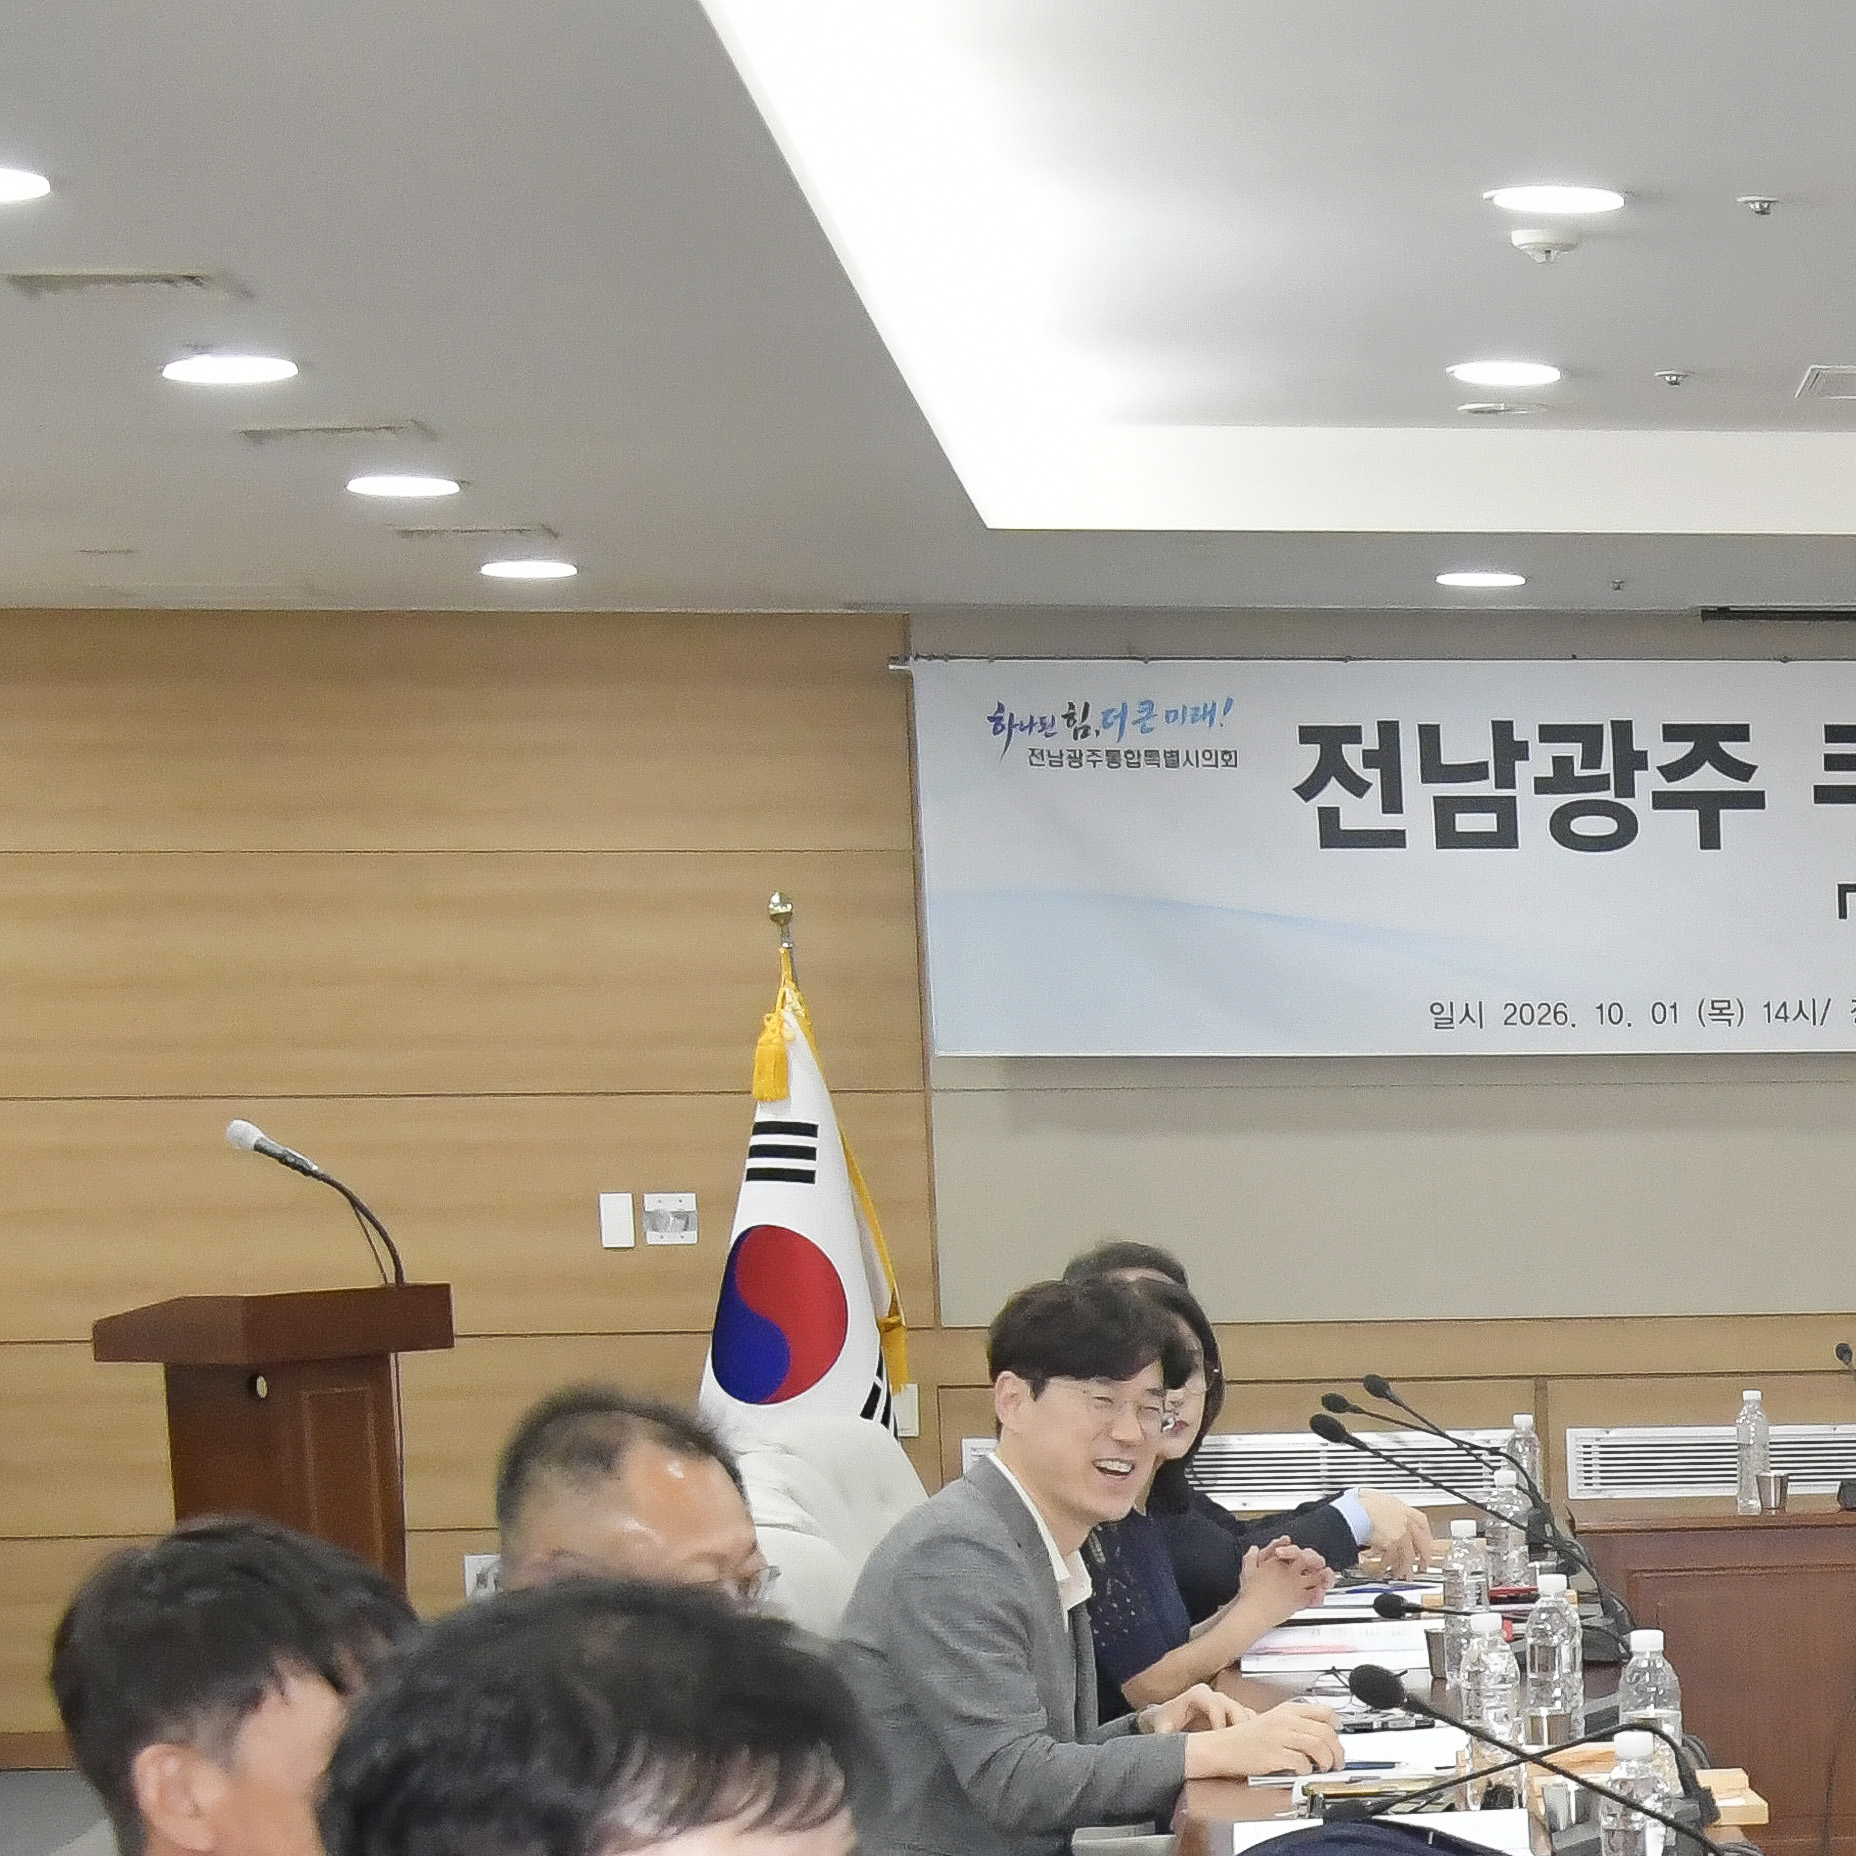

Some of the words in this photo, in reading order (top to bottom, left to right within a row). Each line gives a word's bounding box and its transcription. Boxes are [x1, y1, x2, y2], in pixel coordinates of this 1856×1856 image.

[987, 701, 1058, 762] 하나된
[1101, 702, 1128, 743] 더
[1132, 700, 1158, 734] 큰
[1164, 698, 1234, 729] 미래!
[1028, 747, 1239, 770] 전남광주통합특별시의회
[1292, 719, 1766, 852] 전남광주
[1429, 1000, 1484, 1030] 일시
[1503, 1002, 1577, 1028] 2026.
[1596, 1002, 1633, 1028] 10.
[1651, 1001, 1679, 1025] 01
[1697, 997, 1745, 1028] (목)
[1763, 997, 1832, 1027] 14시/
